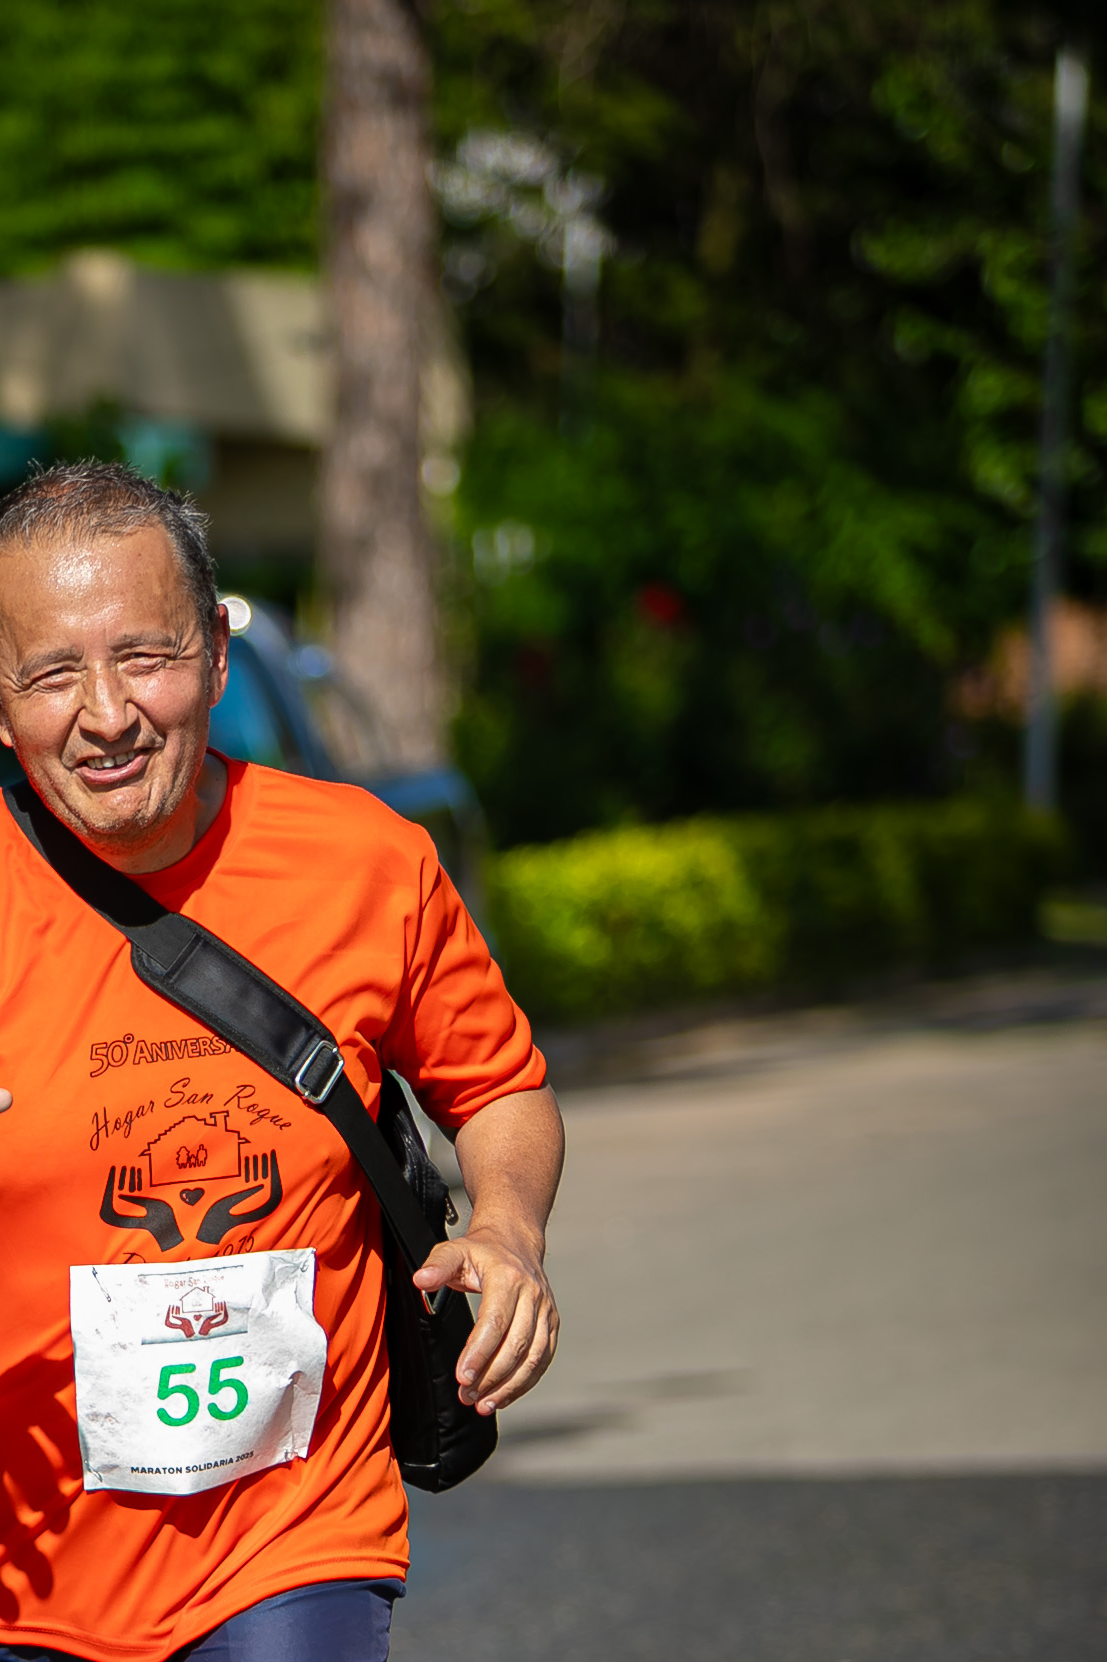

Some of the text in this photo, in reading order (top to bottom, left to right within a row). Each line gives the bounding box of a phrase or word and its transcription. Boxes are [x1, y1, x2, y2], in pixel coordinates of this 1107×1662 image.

[133, 1035, 234, 1065] ANIVERS
[90, 1077, 292, 1151] Hogar San Roque
[156, 1356, 249, 1427] 55
[130, 1450, 255, 1475] MARATON SOLIDARIA 2025
